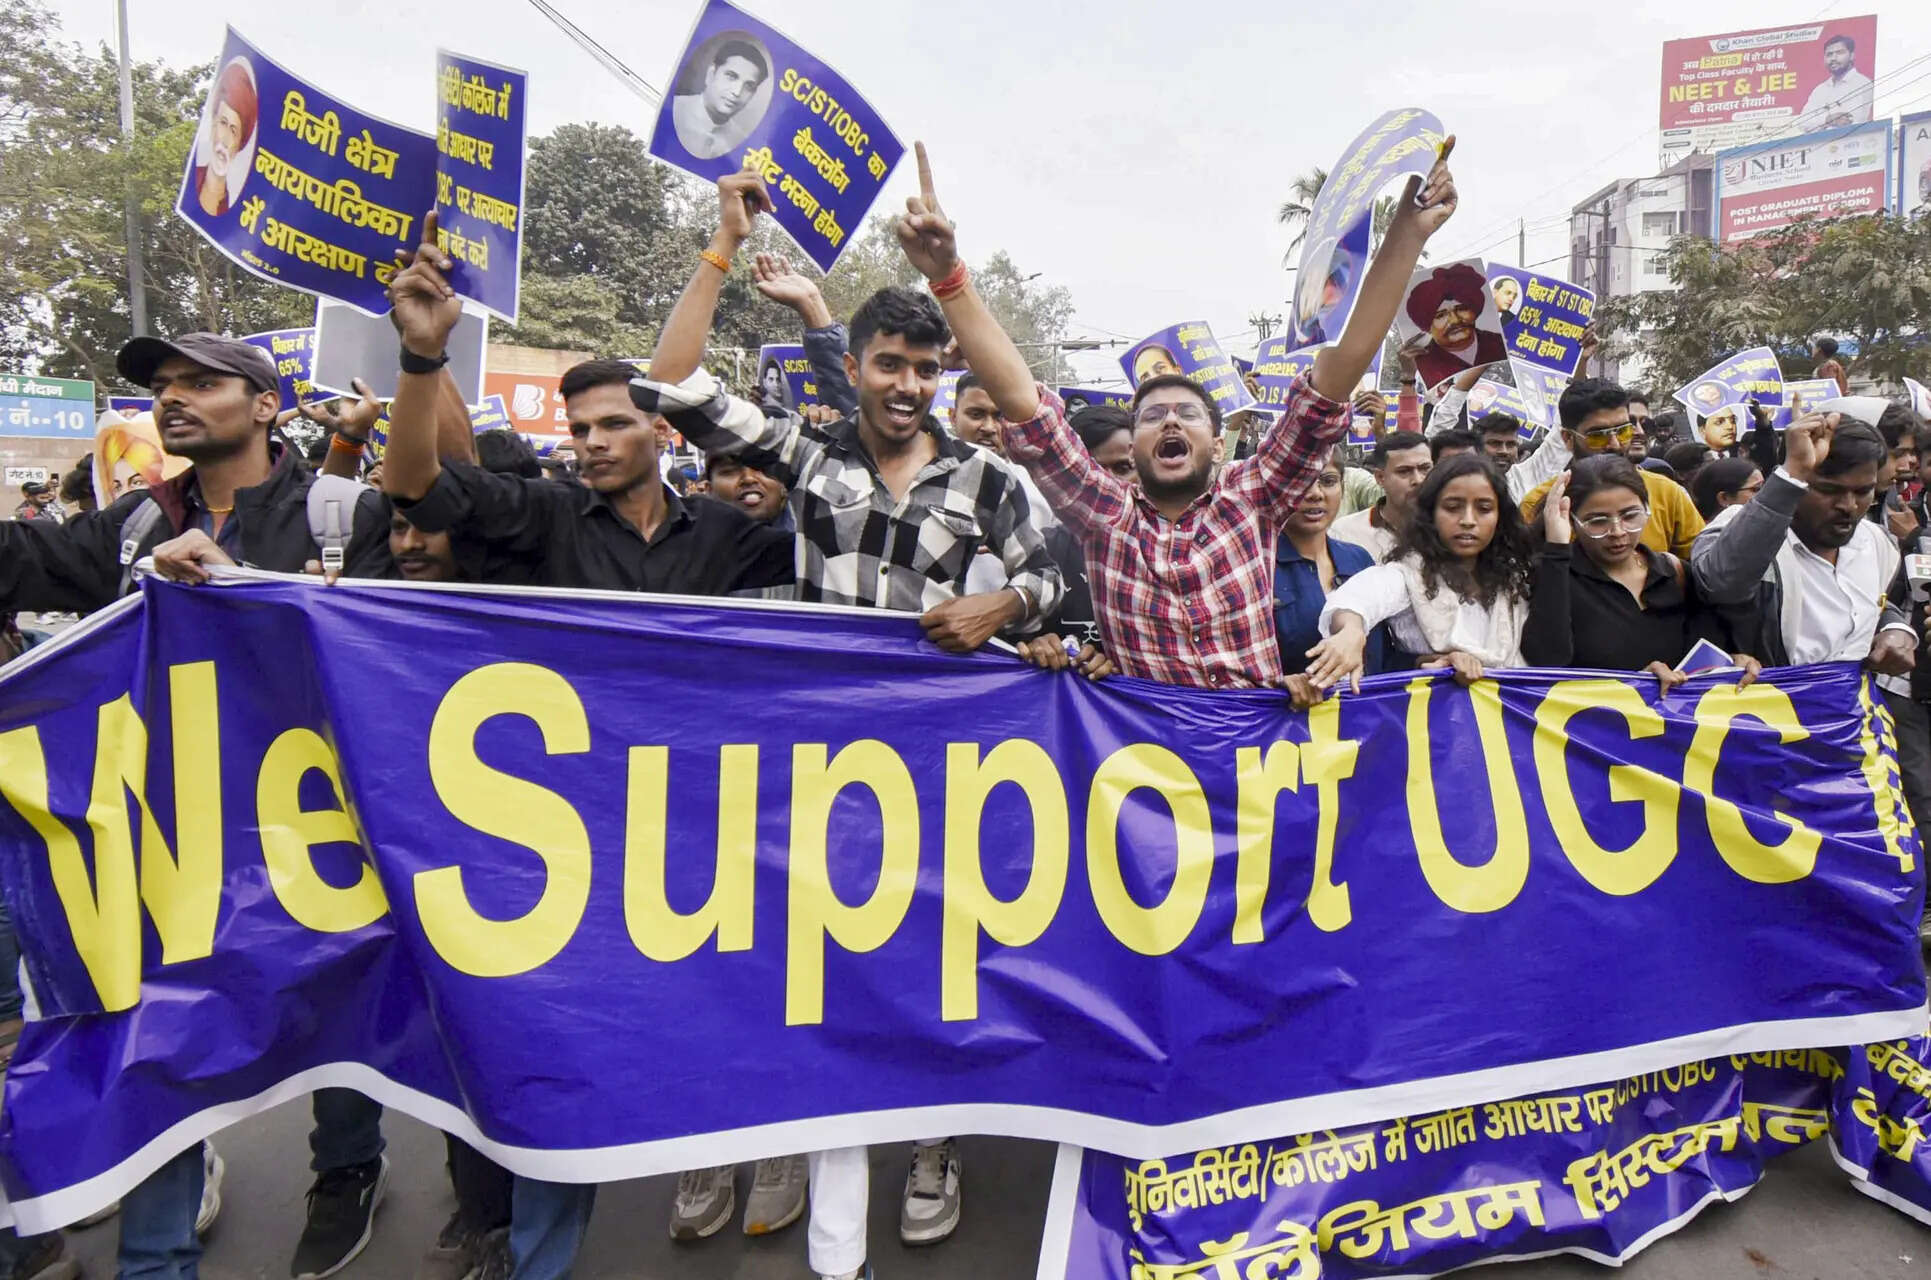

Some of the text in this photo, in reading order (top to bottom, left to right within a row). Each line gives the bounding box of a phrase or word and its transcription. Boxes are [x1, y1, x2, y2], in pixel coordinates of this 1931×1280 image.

[498, 82, 512, 121] में
[1669, 72, 1798, 103] NEET & JEE
[280, 90, 400, 180] निजी क्षेत्र
[779, 68, 888, 182] SC/ST/OBC का
[478, 138, 494, 171] पर
[1752, 148, 1812, 175] NIET
[255, 147, 414, 242] न्यायपालिका
[456, 185, 471, 215] पर
[471, 191, 518, 233] अत्याचार
[779, 174, 819, 221] भरना
[813, 210, 845, 248] होगा
[1730, 187, 1875, 219] POST GRADUATE DIPLOMA
[239, 195, 266, 234] में
[261, 217, 367, 278] आरक्षण
[1734, 215, 1745, 227] IN
[1518, 305, 1543, 328] 65%
[278, 357, 303, 377] 65%
[0, 660, 390, 1012] We
[414, 661, 1358, 1026] Support
[1405, 677, 1824, 914] UGC
[1384, 1116, 1408, 1163] में
[1484, 1094, 1583, 1141] आधार
[1583, 1086, 1616, 1126] पर
